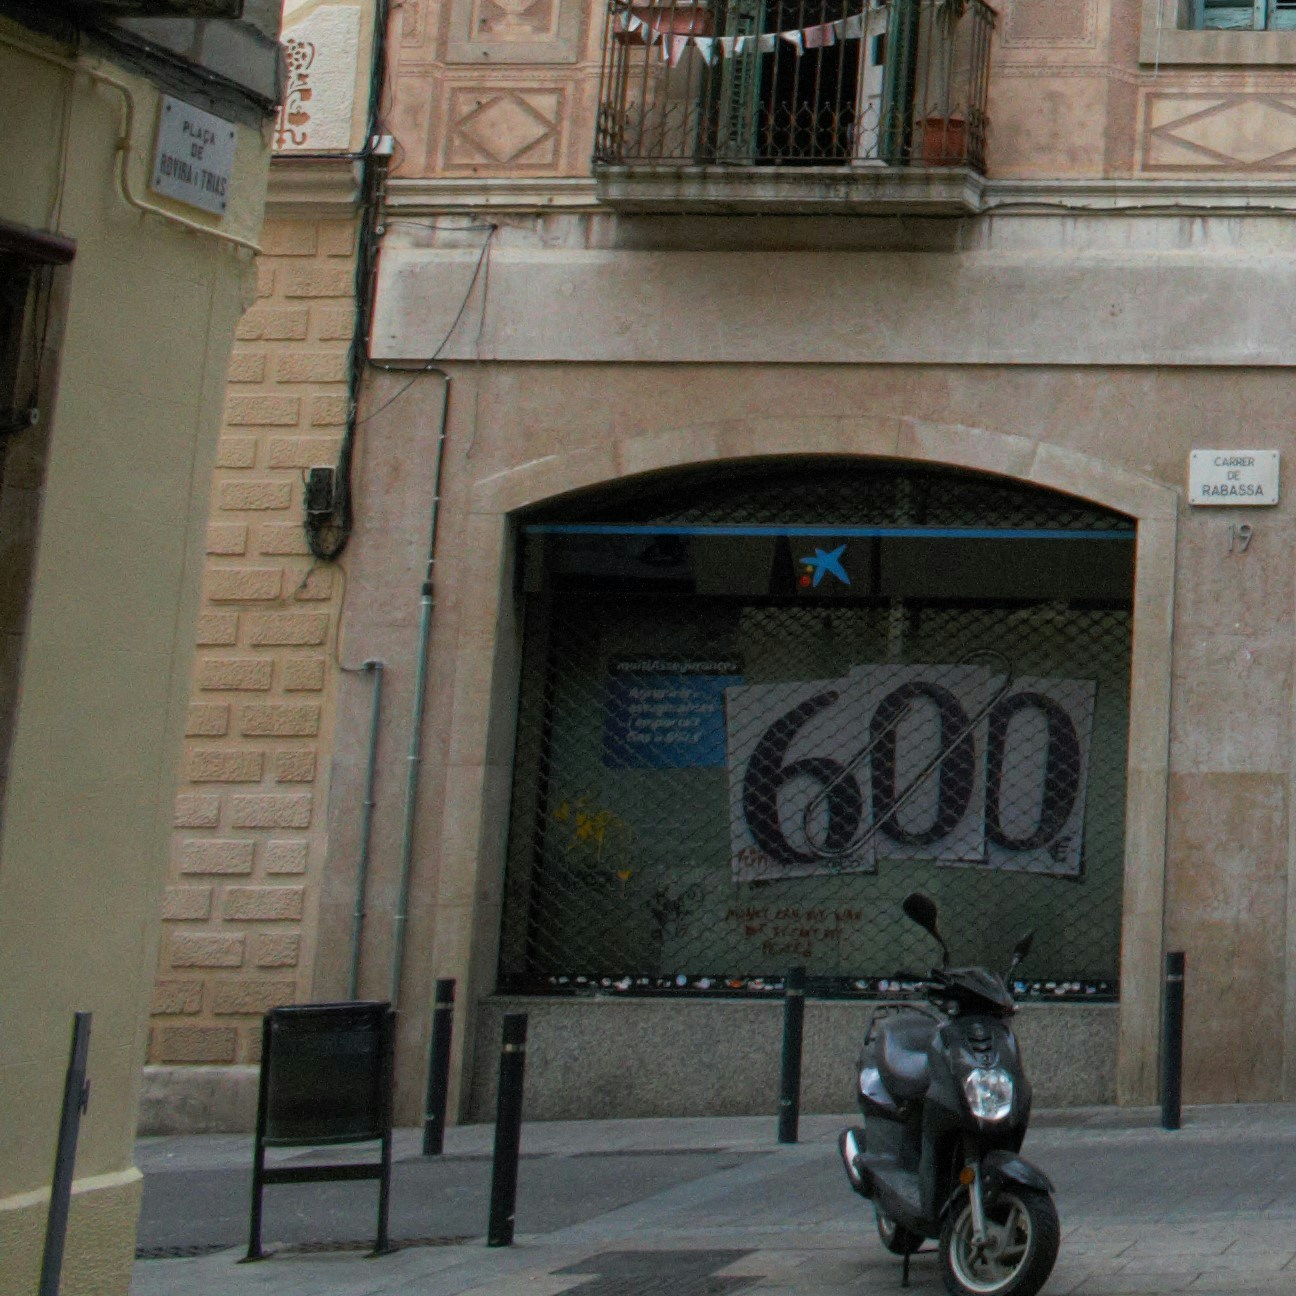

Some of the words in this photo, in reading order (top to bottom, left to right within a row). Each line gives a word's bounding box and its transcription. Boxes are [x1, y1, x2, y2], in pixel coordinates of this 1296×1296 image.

[183, 120, 215, 145] PLAÇA
[191, 142, 204, 161] DE
[160, 153, 192, 183] ROVIRA
[202, 169, 227, 196] TRIAS
[1214, 457, 1255, 467] CARRER
[1227, 470, 1240, 481] DE
[1202, 484, 1264, 496] RABASSA
[1228, 523, 1253, 554] 19
[742, 680, 1081, 866] 600
